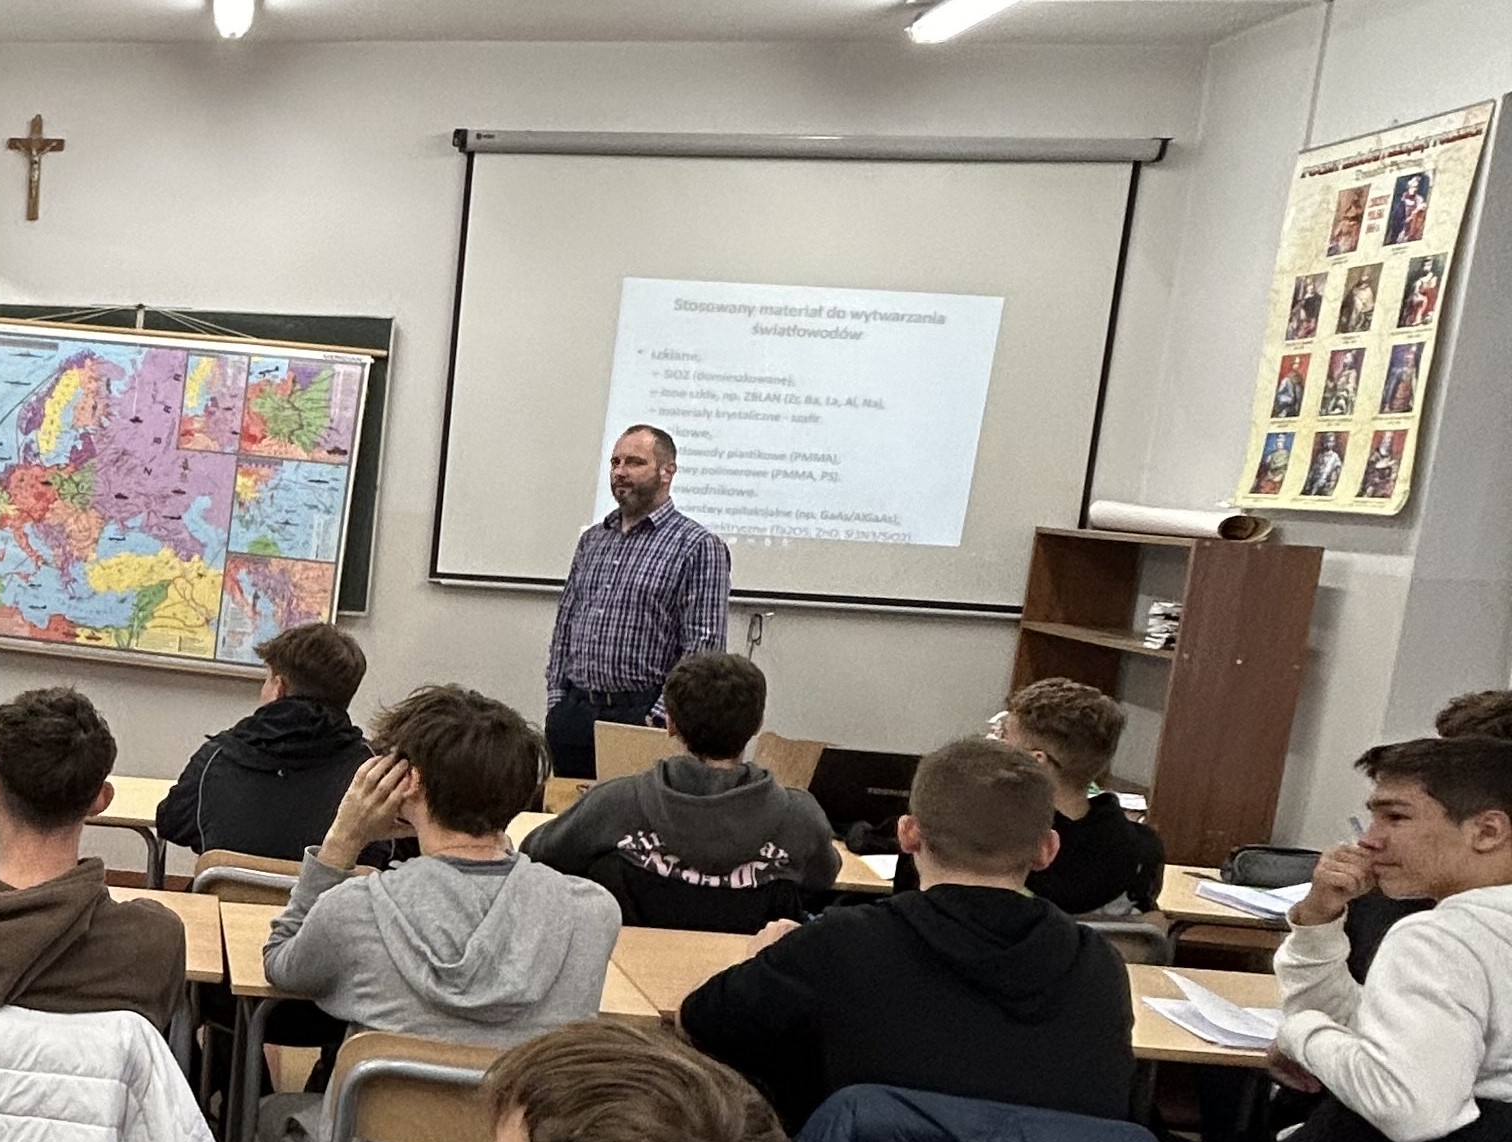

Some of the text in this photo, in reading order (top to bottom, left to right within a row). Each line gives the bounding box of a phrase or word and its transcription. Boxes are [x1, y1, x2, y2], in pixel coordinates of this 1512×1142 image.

[673, 298, 947, 327] Stosowany materiał do wytwarzania
[751, 322, 864, 341] światłowodów
